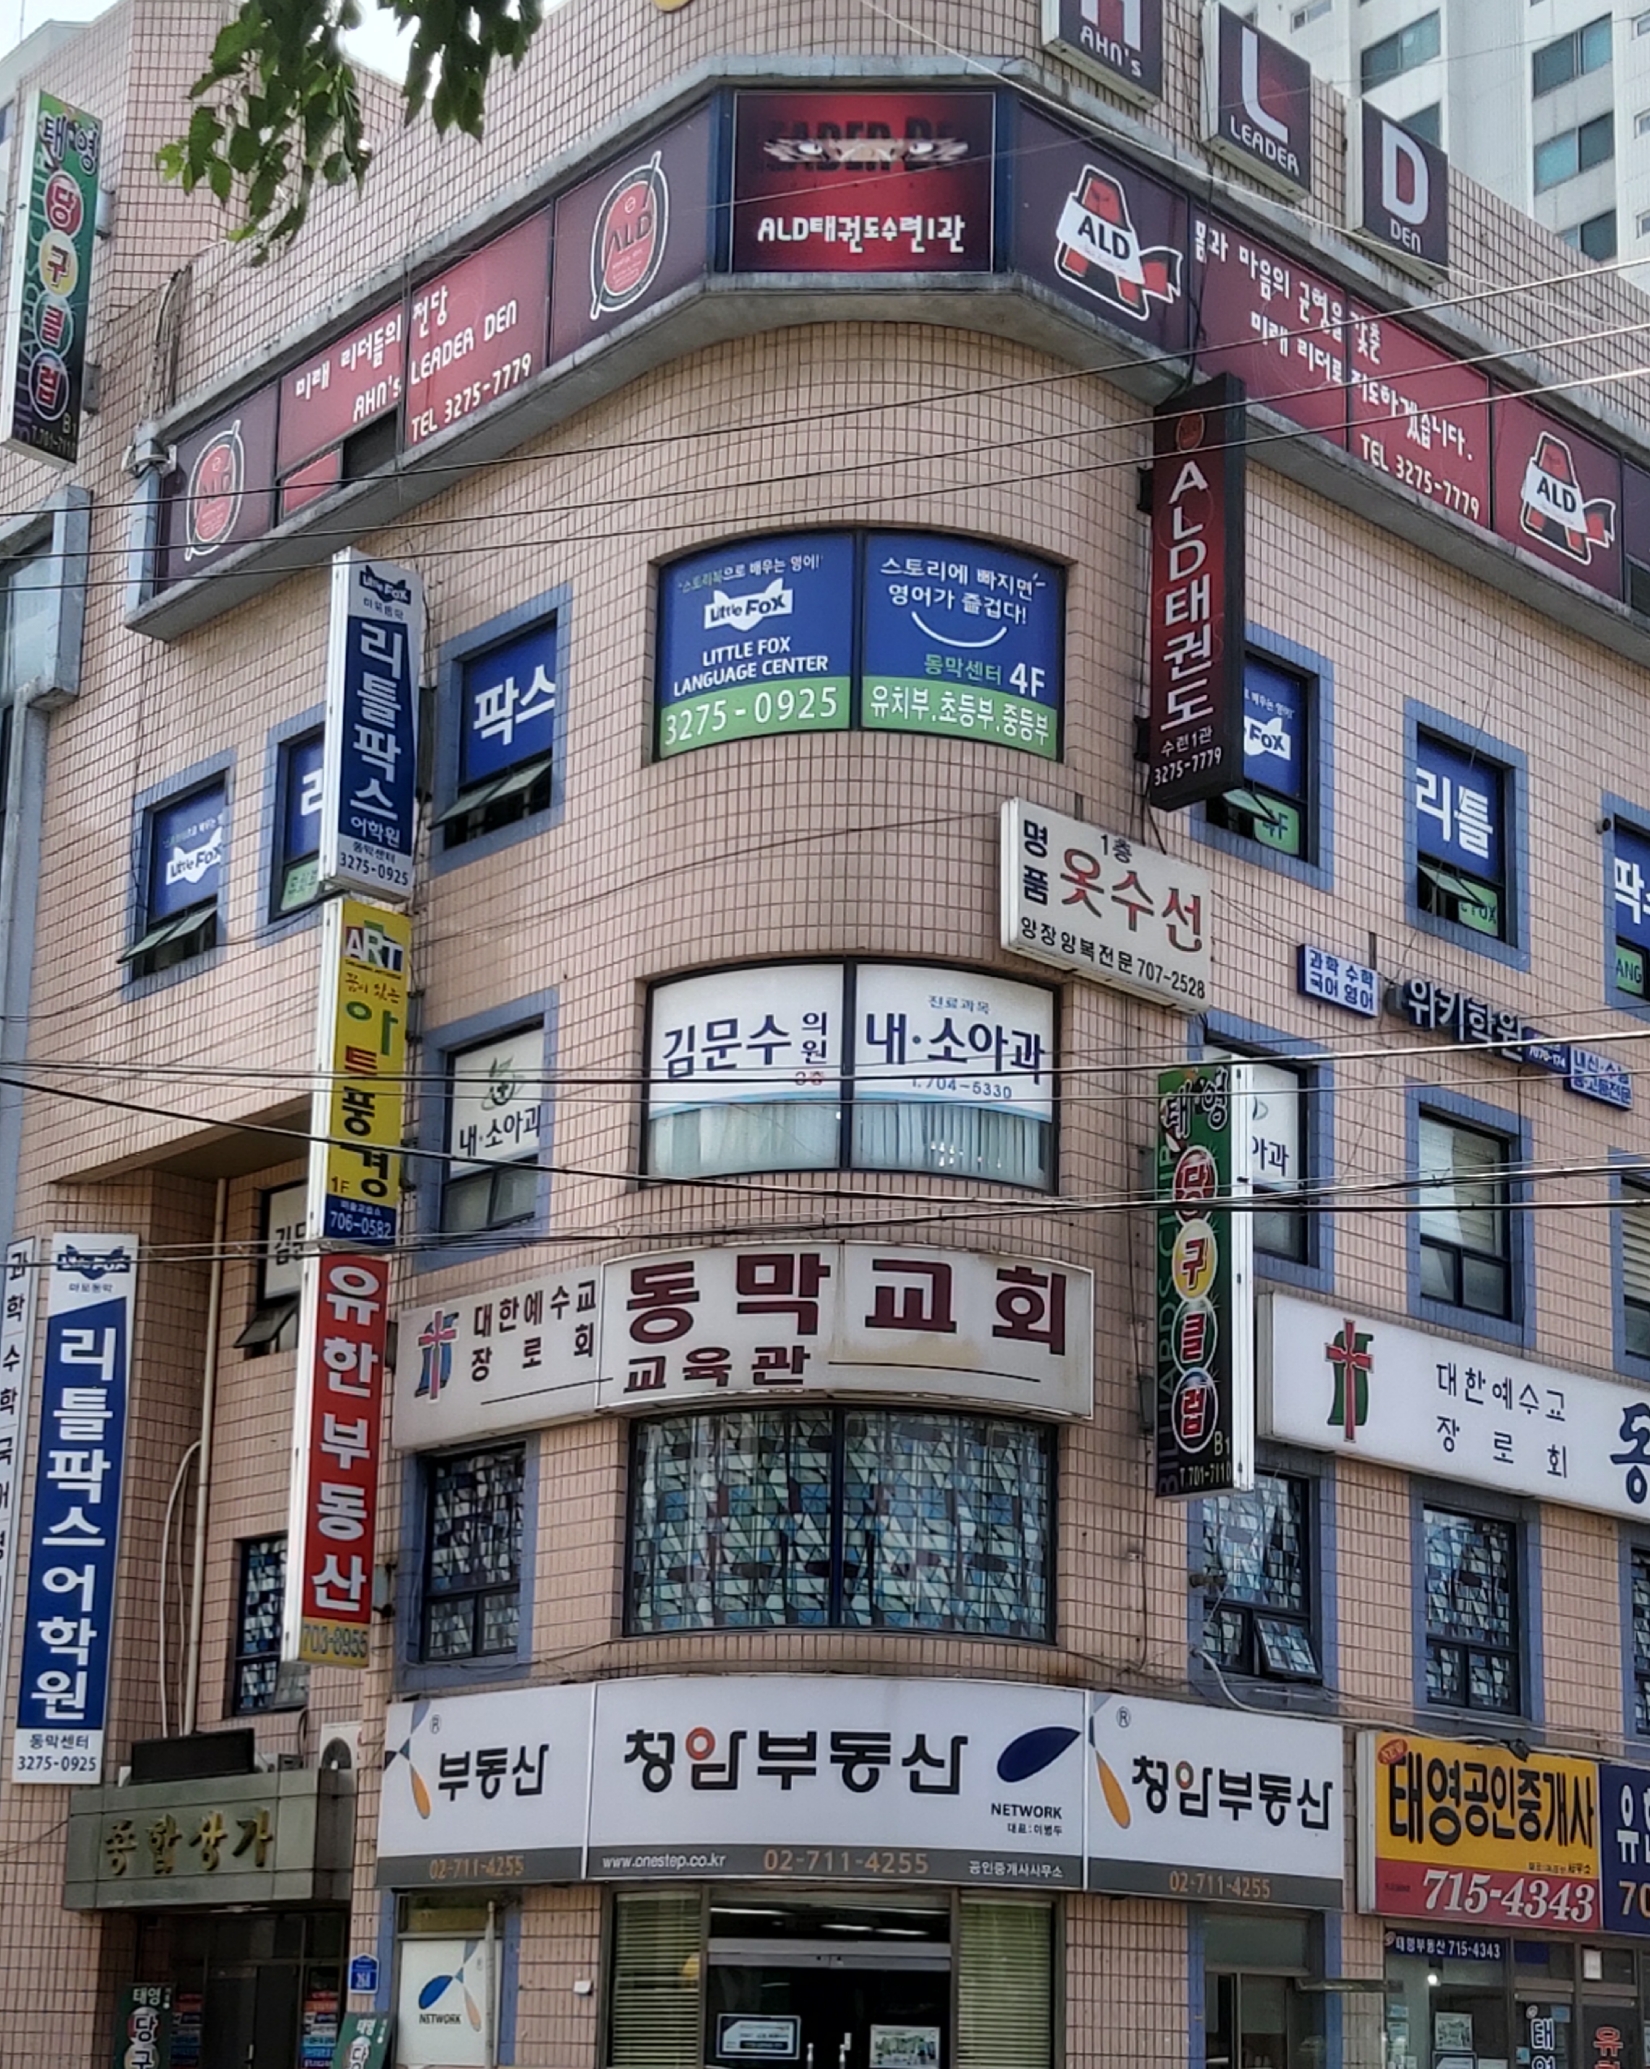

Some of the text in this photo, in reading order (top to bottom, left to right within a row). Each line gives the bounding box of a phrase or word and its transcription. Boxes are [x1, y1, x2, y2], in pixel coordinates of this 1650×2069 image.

[1080, 25, 1141, 78] AHN's
[1230, 115, 1300, 176] LEADER
[1382, 120, 1429, 225] D
[1078, 215, 1130, 260] ALD
[1390, 218, 1421, 254] DEN
[1195, 220, 1229, 263] 몸과
[1239, 245, 1290, 301] 마음의
[295, 286, 448, 400] 미래 리더들의 전당
[353, 300, 517, 422] AHN's LEADER DEN
[1250, 311, 1288, 357] 미래
[1296, 338, 1343, 384] 리더로
[412, 353, 532, 443] TEL 3275-7779
[1361, 434, 1480, 520] TEL 3275-7779
[1537, 478, 1576, 513] ALD
[880, 557, 967, 586] 스토리에
[710, 603, 743, 622] Little
[888, 584, 1028, 625] 영어가 즐겁다!
[702, 636, 791, 667] LITTLE FOX
[673, 655, 829, 698] LANGUAGE CENTER
[924, 655, 1046, 699] 동막센터 4F
[350, 621, 403, 821] 리틀팍스
[473, 665, 556, 746] 팍스
[1154, 745, 1223, 787] 3275-7779
[350, 816, 400, 848] 어학원
[1416, 767, 1494, 859] 리틀
[339, 851, 409, 886] 3275-0925
[1024, 819, 1049, 906] 명품
[1101, 834, 1133, 863] 1층
[1060, 848, 1203, 953] 옷수선
[345, 928, 403, 972] ART
[1137, 958, 1206, 1000] 707-2528
[1408, 976, 1524, 1063] 위키학원
[663, 1013, 792, 1081] 김문수
[331, 1176, 350, 1194] 1F
[330, 1210, 392, 1239] 706-0582
[473, 1279, 597, 1338] 대한예수교
[626, 1252, 1067, 1356] 동막교회
[623, 1345, 811, 1393] 교육관
[1436, 1361, 1566, 1422] 대한예수교
[311, 1265, 379, 1612] 유한부동산
[17, 1755, 98, 1772] 3275-0925
[28, 1733, 90, 1750] 동막센터
[437, 1743, 550, 1802] 부동산
[990, 1802, 1063, 1820] NETWORK
[1388, 1750, 1595, 1849] 태영공인중개사
[105, 1807, 274, 1876] 종합상가
[602, 1849, 1063, 1879] www.onestep.co.kr 02-711-4255 공인중개사사무소
[428, 1855, 525, 1880] 02-711-4255
[1169, 1869, 1271, 1900] 02-711-4255
[1421, 1867, 1596, 1923] 715-4343
[1448, 1939, 1501, 1960] 715-4343
[133, 1986, 161, 2007] 태영
[419, 2013, 461, 2024] NETWORK
